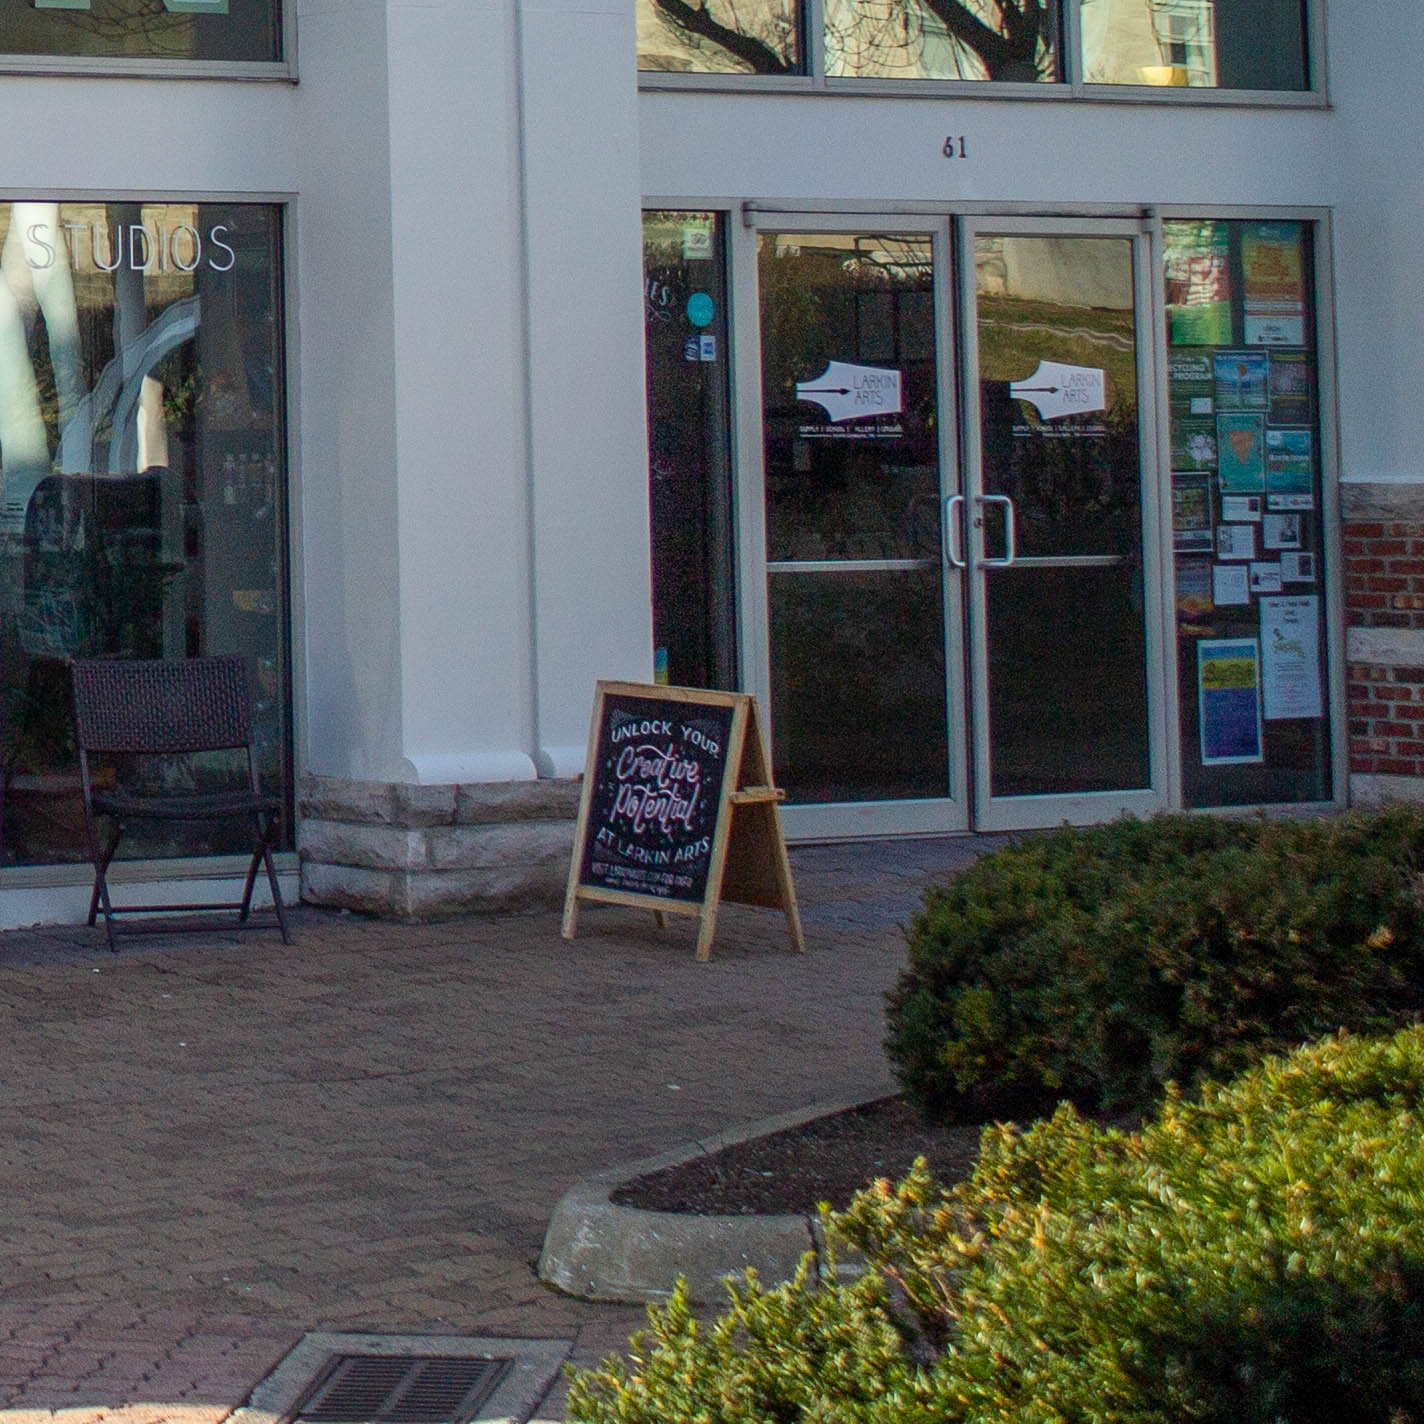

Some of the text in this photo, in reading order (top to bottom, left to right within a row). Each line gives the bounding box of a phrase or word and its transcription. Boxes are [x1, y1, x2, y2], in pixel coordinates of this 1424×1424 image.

[942, 135, 968, 159] 61
[25, 222, 236, 272] STUDIOS
[853, 375, 897, 390] LARKIN
[854, 390, 884, 406] ARTS
[1062, 389, 1089, 404] ARTS
[611, 720, 720, 759] UNLOCK YOUR
[596, 826, 710, 864] AT LARKIN ARTS
